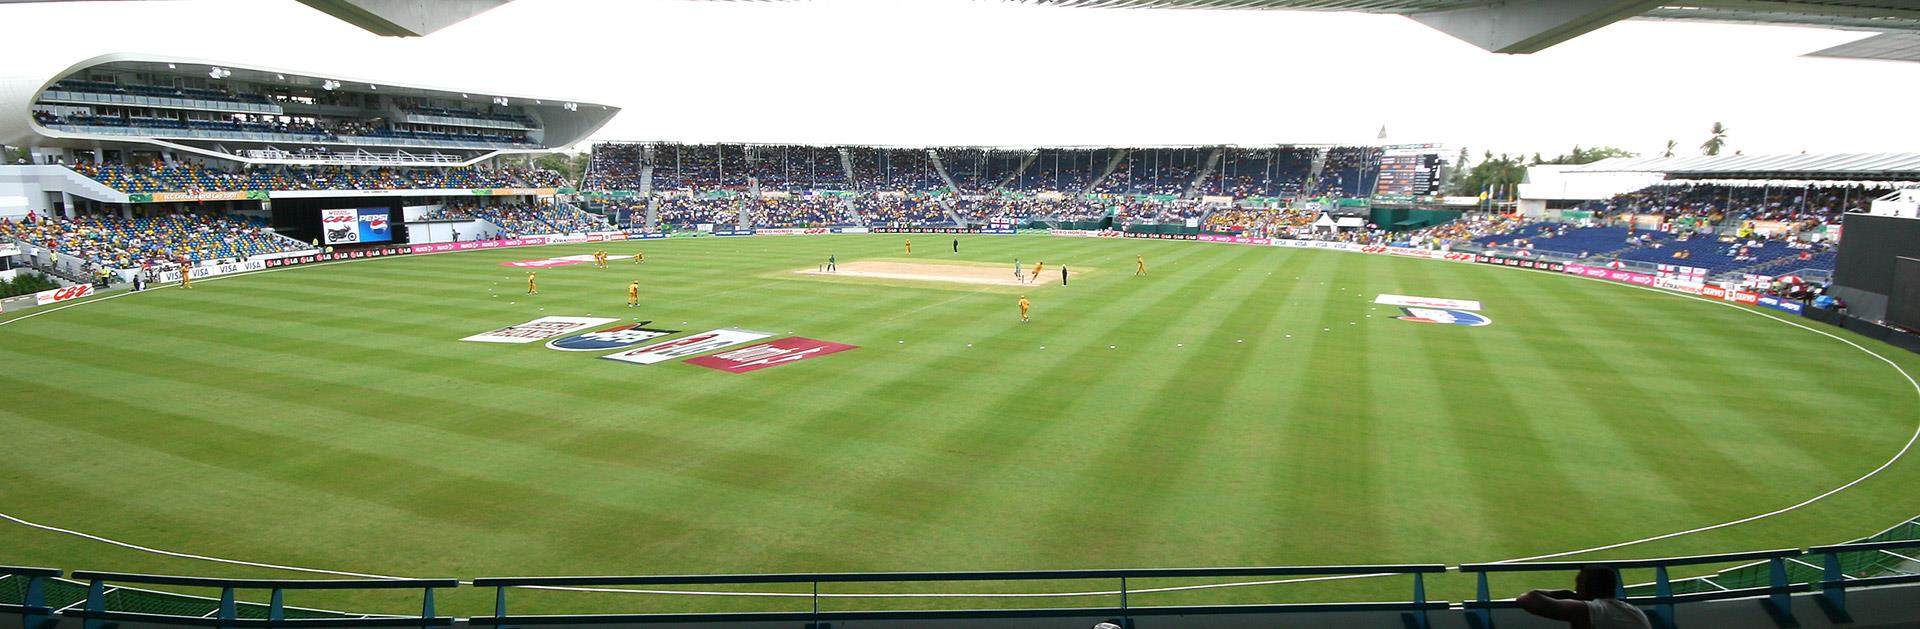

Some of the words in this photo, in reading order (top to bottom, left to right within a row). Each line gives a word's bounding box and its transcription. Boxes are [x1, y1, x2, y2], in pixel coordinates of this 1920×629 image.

[359, 214, 388, 222] PEPSI
[220, 264, 238, 273] VISA
[244, 261, 261, 270] VISA
[192, 267, 209, 277] VISA
[1703, 287, 1724, 298] SERVO
